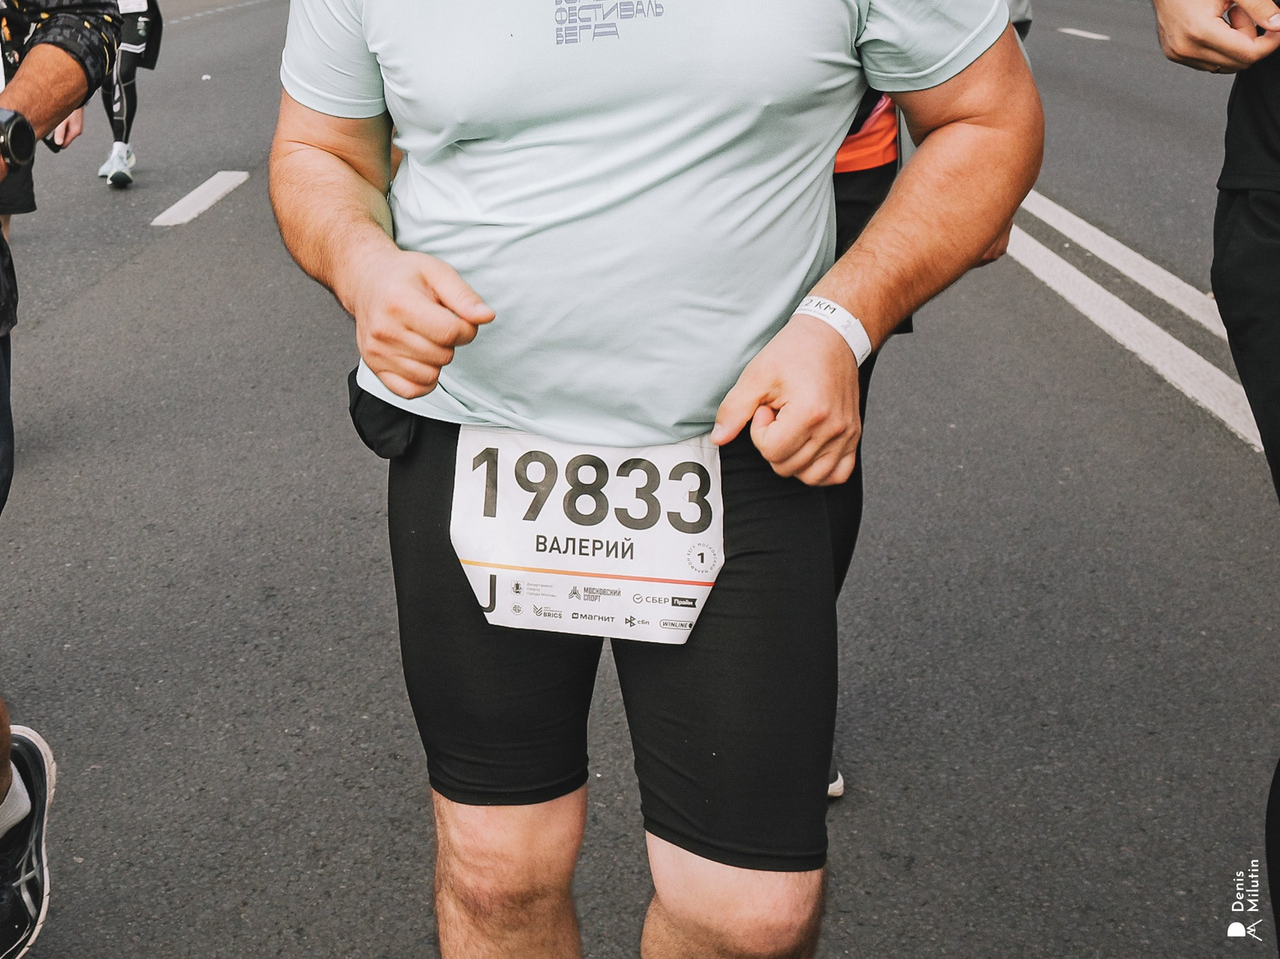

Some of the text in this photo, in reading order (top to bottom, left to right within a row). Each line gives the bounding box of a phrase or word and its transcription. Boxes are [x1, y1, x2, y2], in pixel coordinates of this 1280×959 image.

[554, 0, 664, 26] ФЕСТИВАЛЬ
[555, 23, 620, 45] БЕГА
[472, 447, 713, 535] 19833
[535, 534, 635, 560] ВАЛЕРИЙ
[697, 552, 705, 564] 1
[480, 574, 497, 614] J
[583, 586, 622, 597] МОСКОВСКИЙ
[645, 596, 670, 605] СБЕР
[543, 611, 563, 619] BRICS
